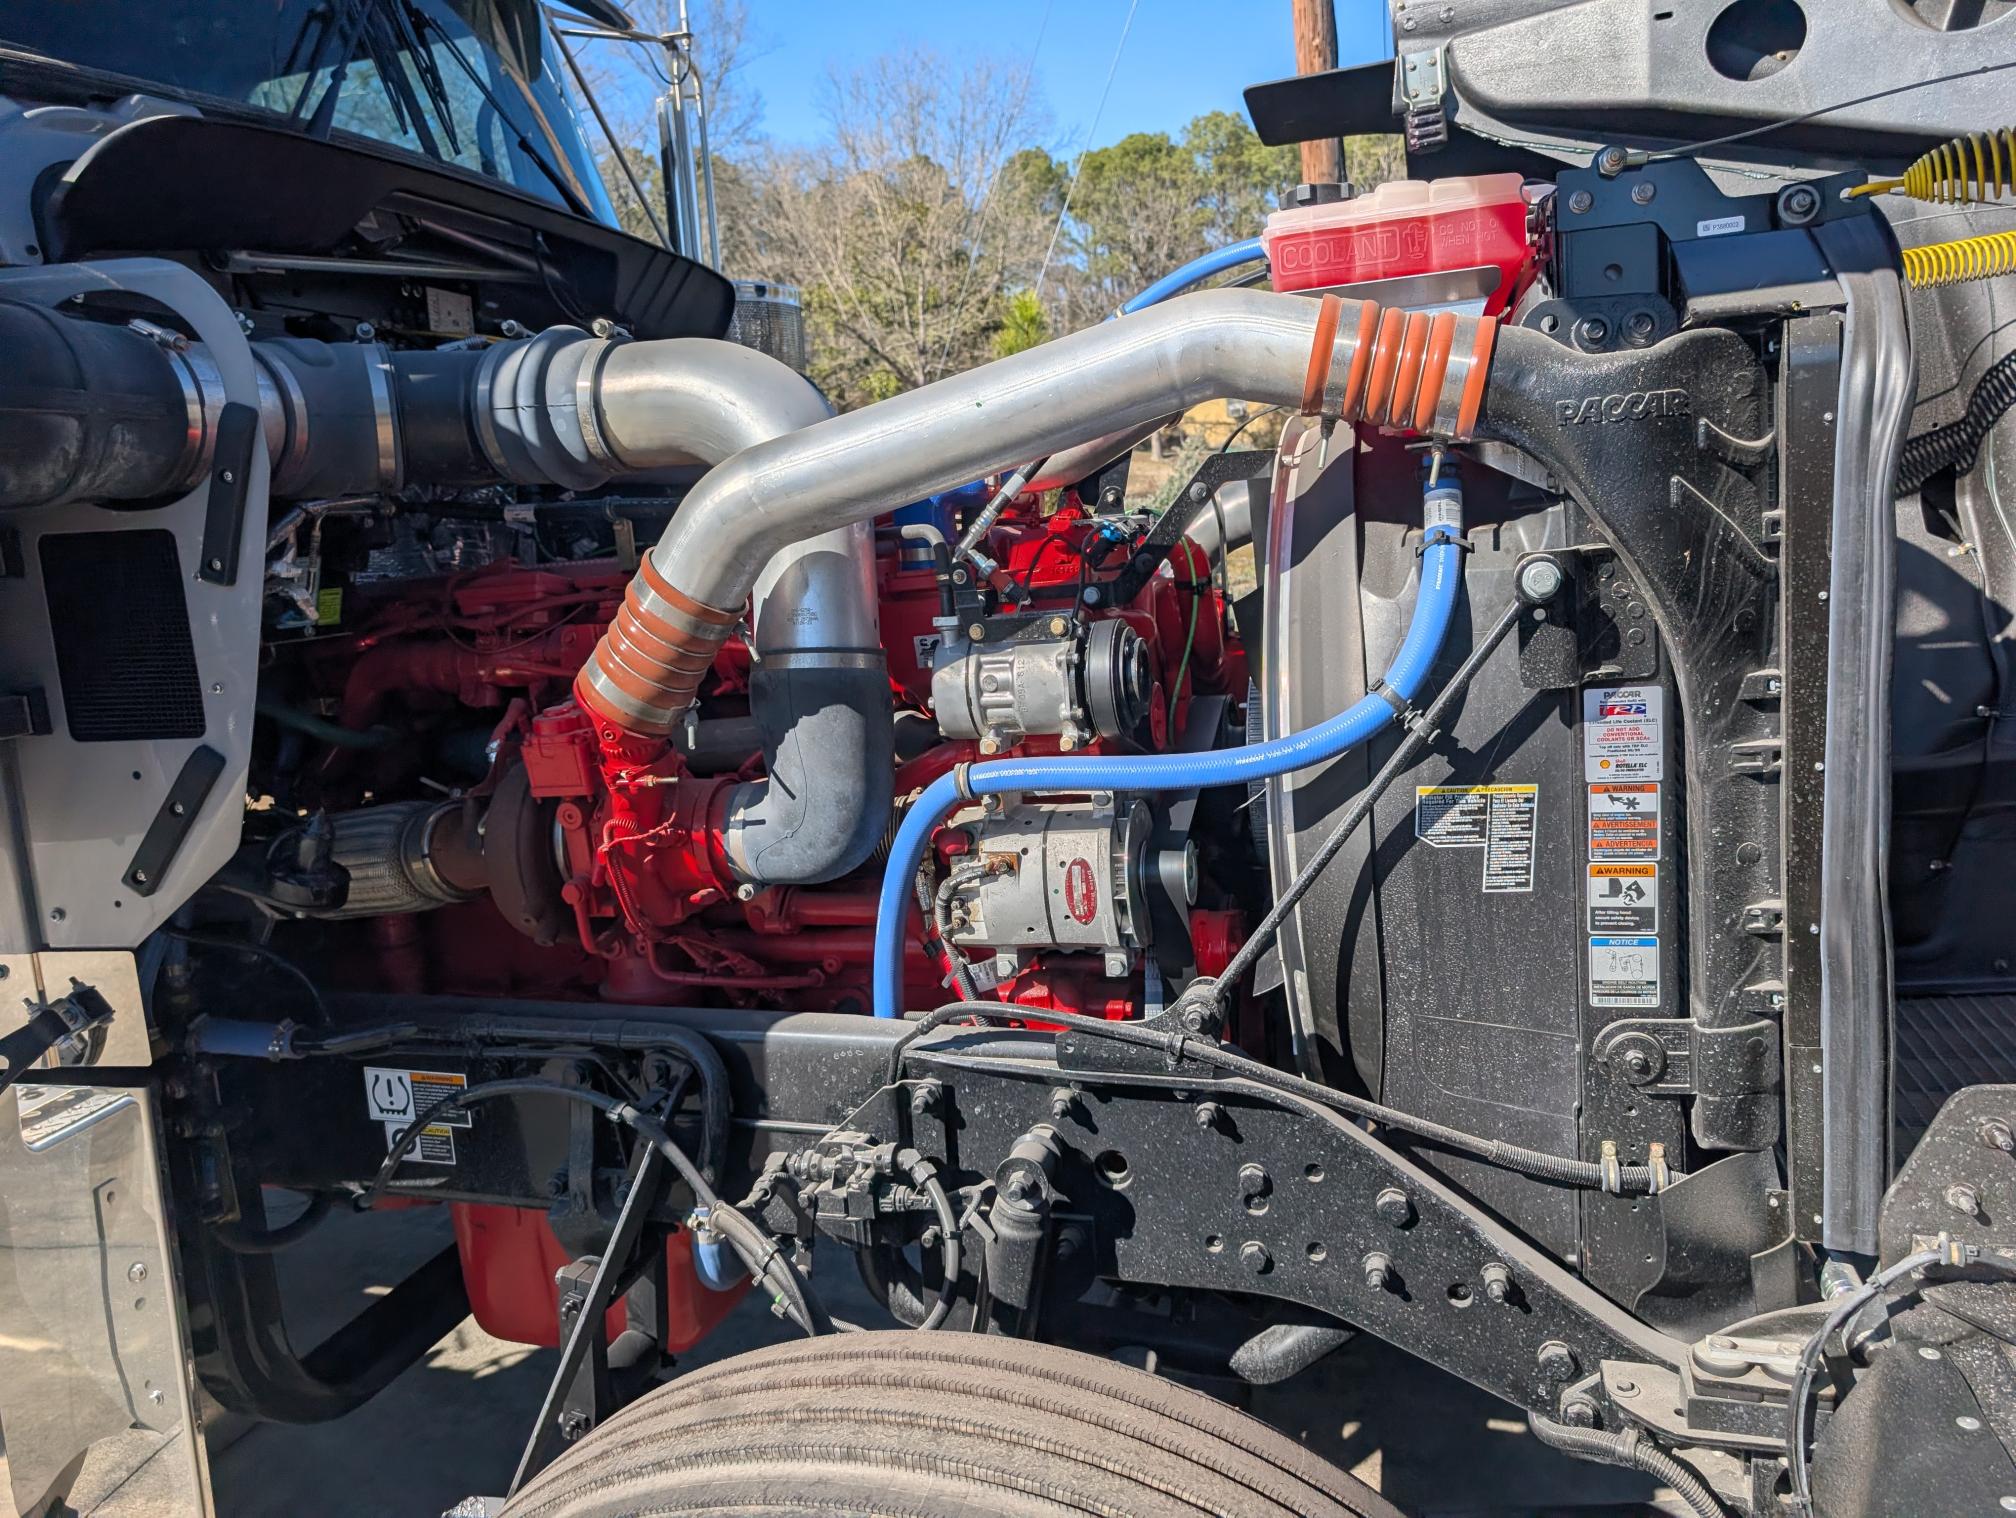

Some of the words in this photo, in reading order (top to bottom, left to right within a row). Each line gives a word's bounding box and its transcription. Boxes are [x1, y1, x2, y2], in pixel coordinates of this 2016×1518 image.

[1439, 223, 1454, 236] DO
[1461, 219, 1480, 232] NOT
[1476, 230, 1497, 241] HOT
[1282, 231, 1392, 270] COOLANT
[1555, 388, 1690, 426] PACCAR
[1603, 690, 1642, 699] PACCAR
[1600, 703, 1647, 716] TRP
[1612, 784, 1645, 792] WARNING
[1603, 867, 1649, 875] WARNING
